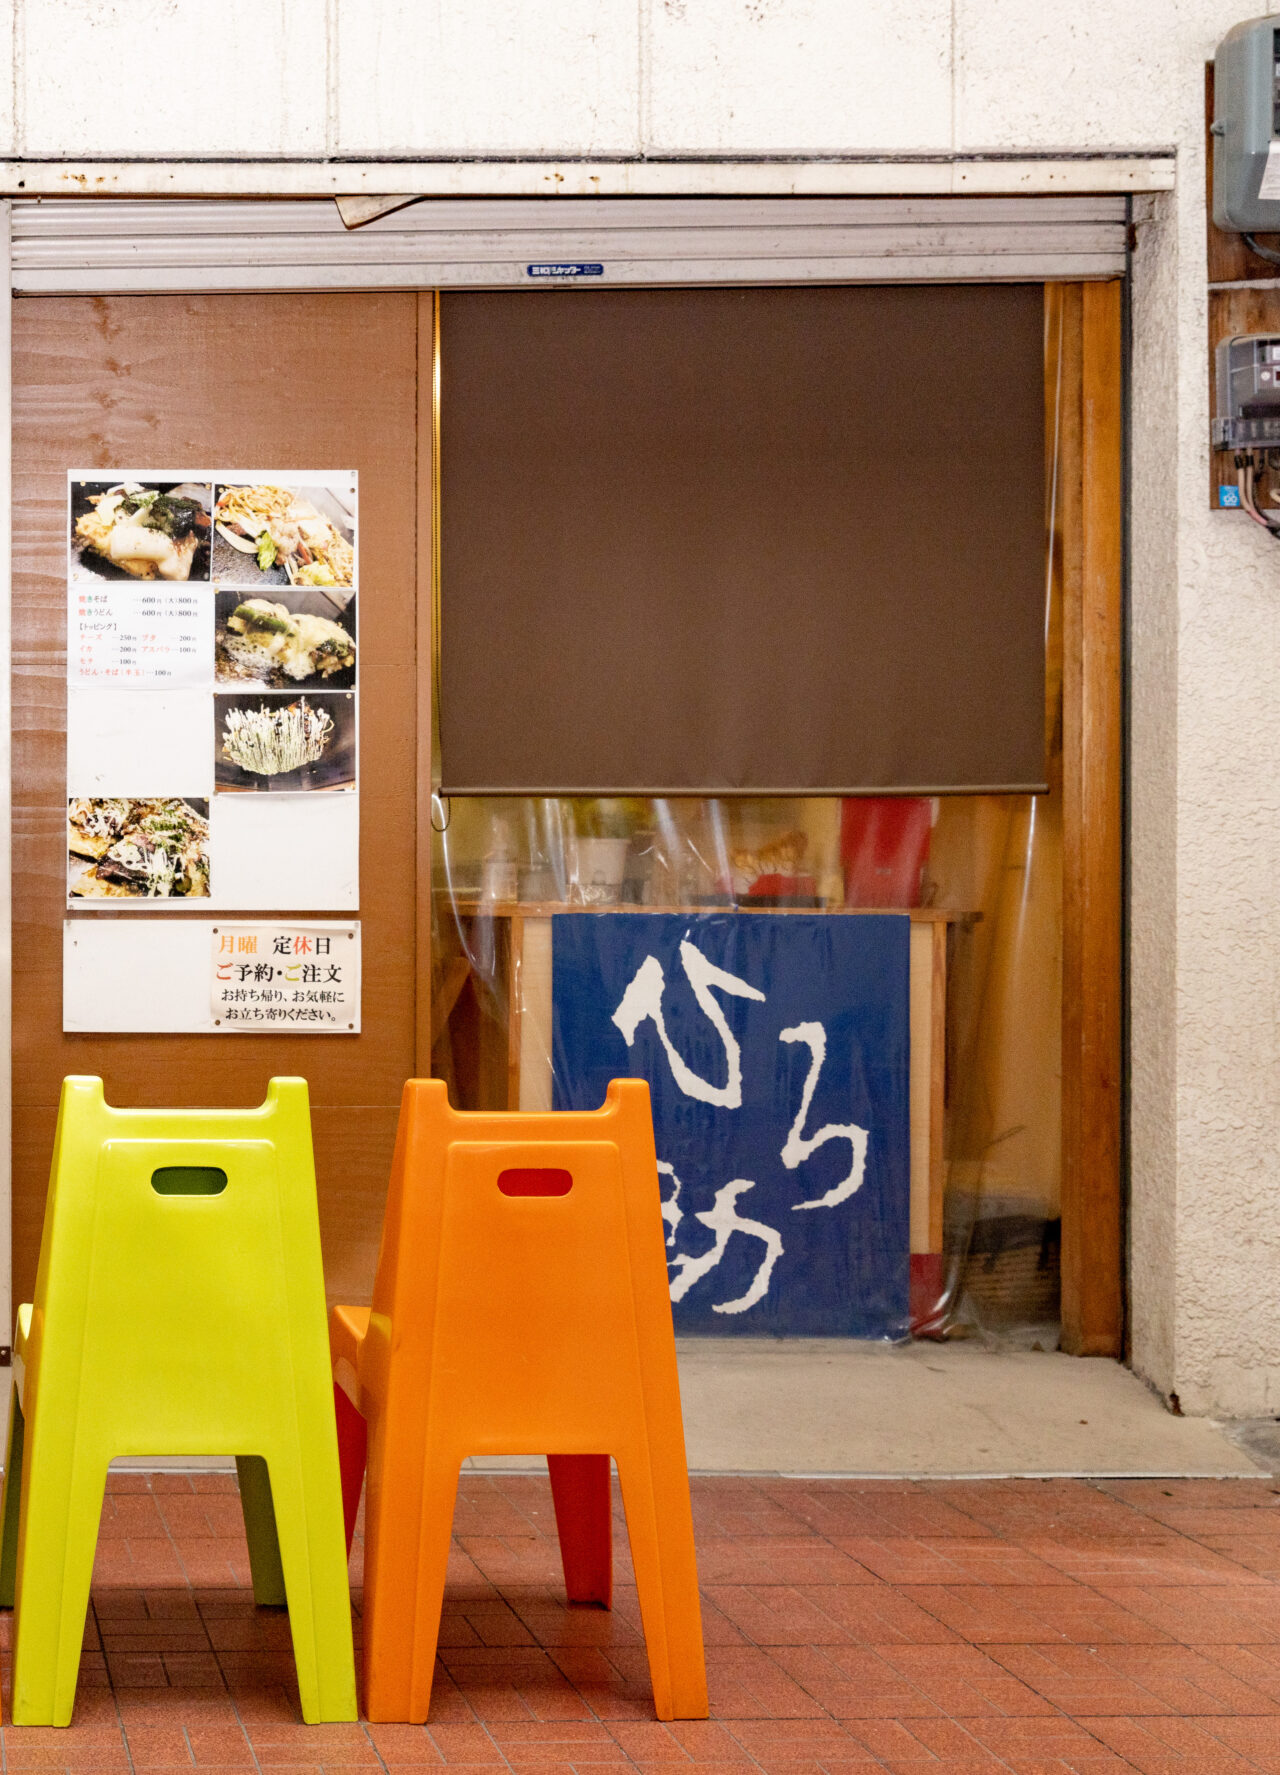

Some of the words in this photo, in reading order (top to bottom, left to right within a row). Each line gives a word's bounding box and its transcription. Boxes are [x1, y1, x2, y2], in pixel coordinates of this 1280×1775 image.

[78, 608, 113, 617] 焼きうどん
[219, 935, 258, 954] 月曜
[273, 936, 330, 955] 定休日
[216, 963, 342, 983] ご予約・ご注文
[221, 989, 345, 1003] お持ち帰り、お気軽に
[225, 1008, 336, 1022] お立ち寄りください。
